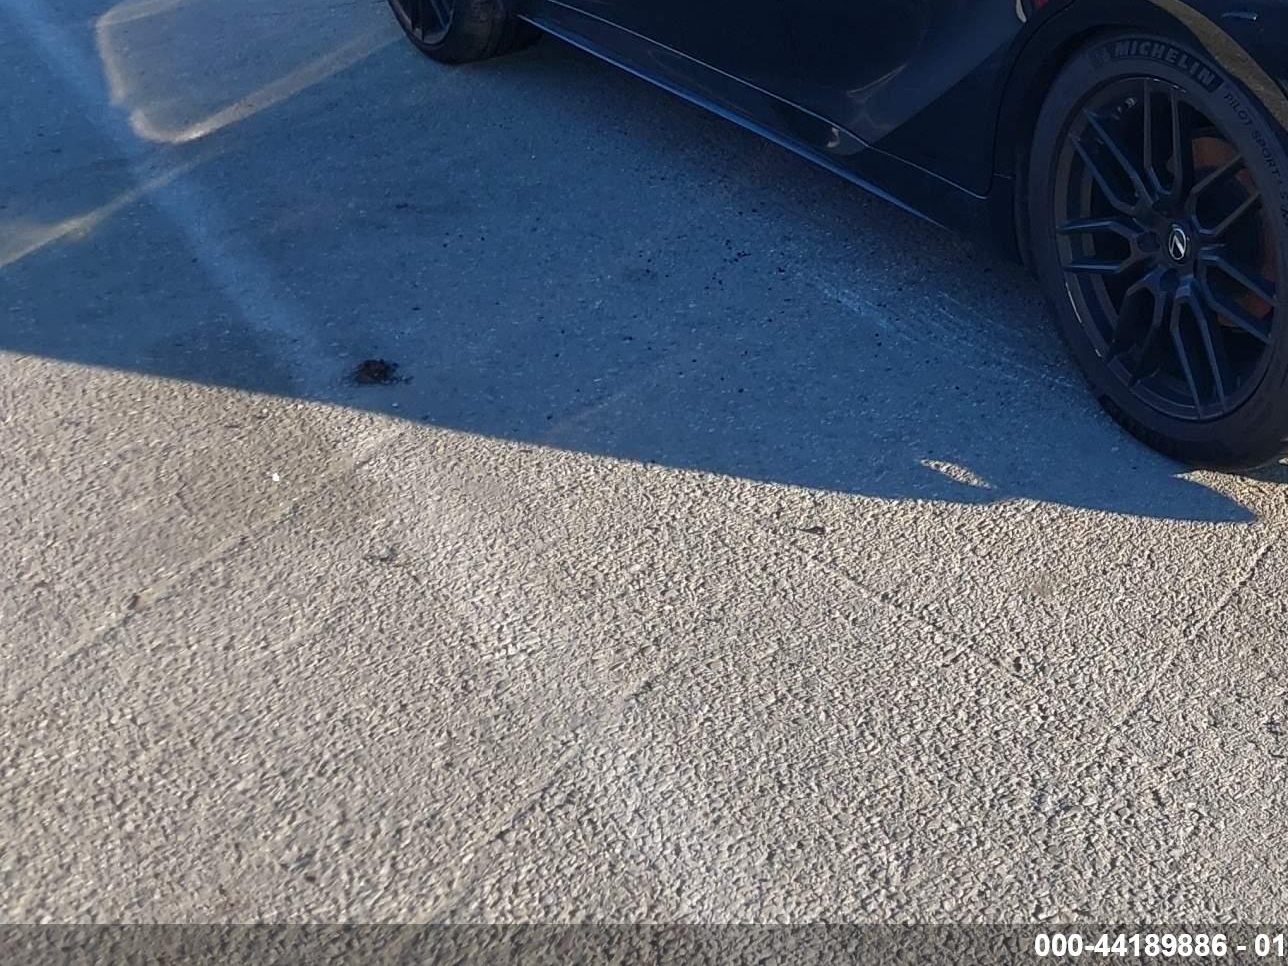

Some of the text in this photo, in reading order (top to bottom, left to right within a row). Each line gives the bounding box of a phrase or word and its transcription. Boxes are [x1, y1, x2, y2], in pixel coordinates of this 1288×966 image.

[1113, 40, 1215, 85] MICHELIN
[1223, 91, 1254, 126] PILOT
[1250, 130, 1282, 178] SPORT
